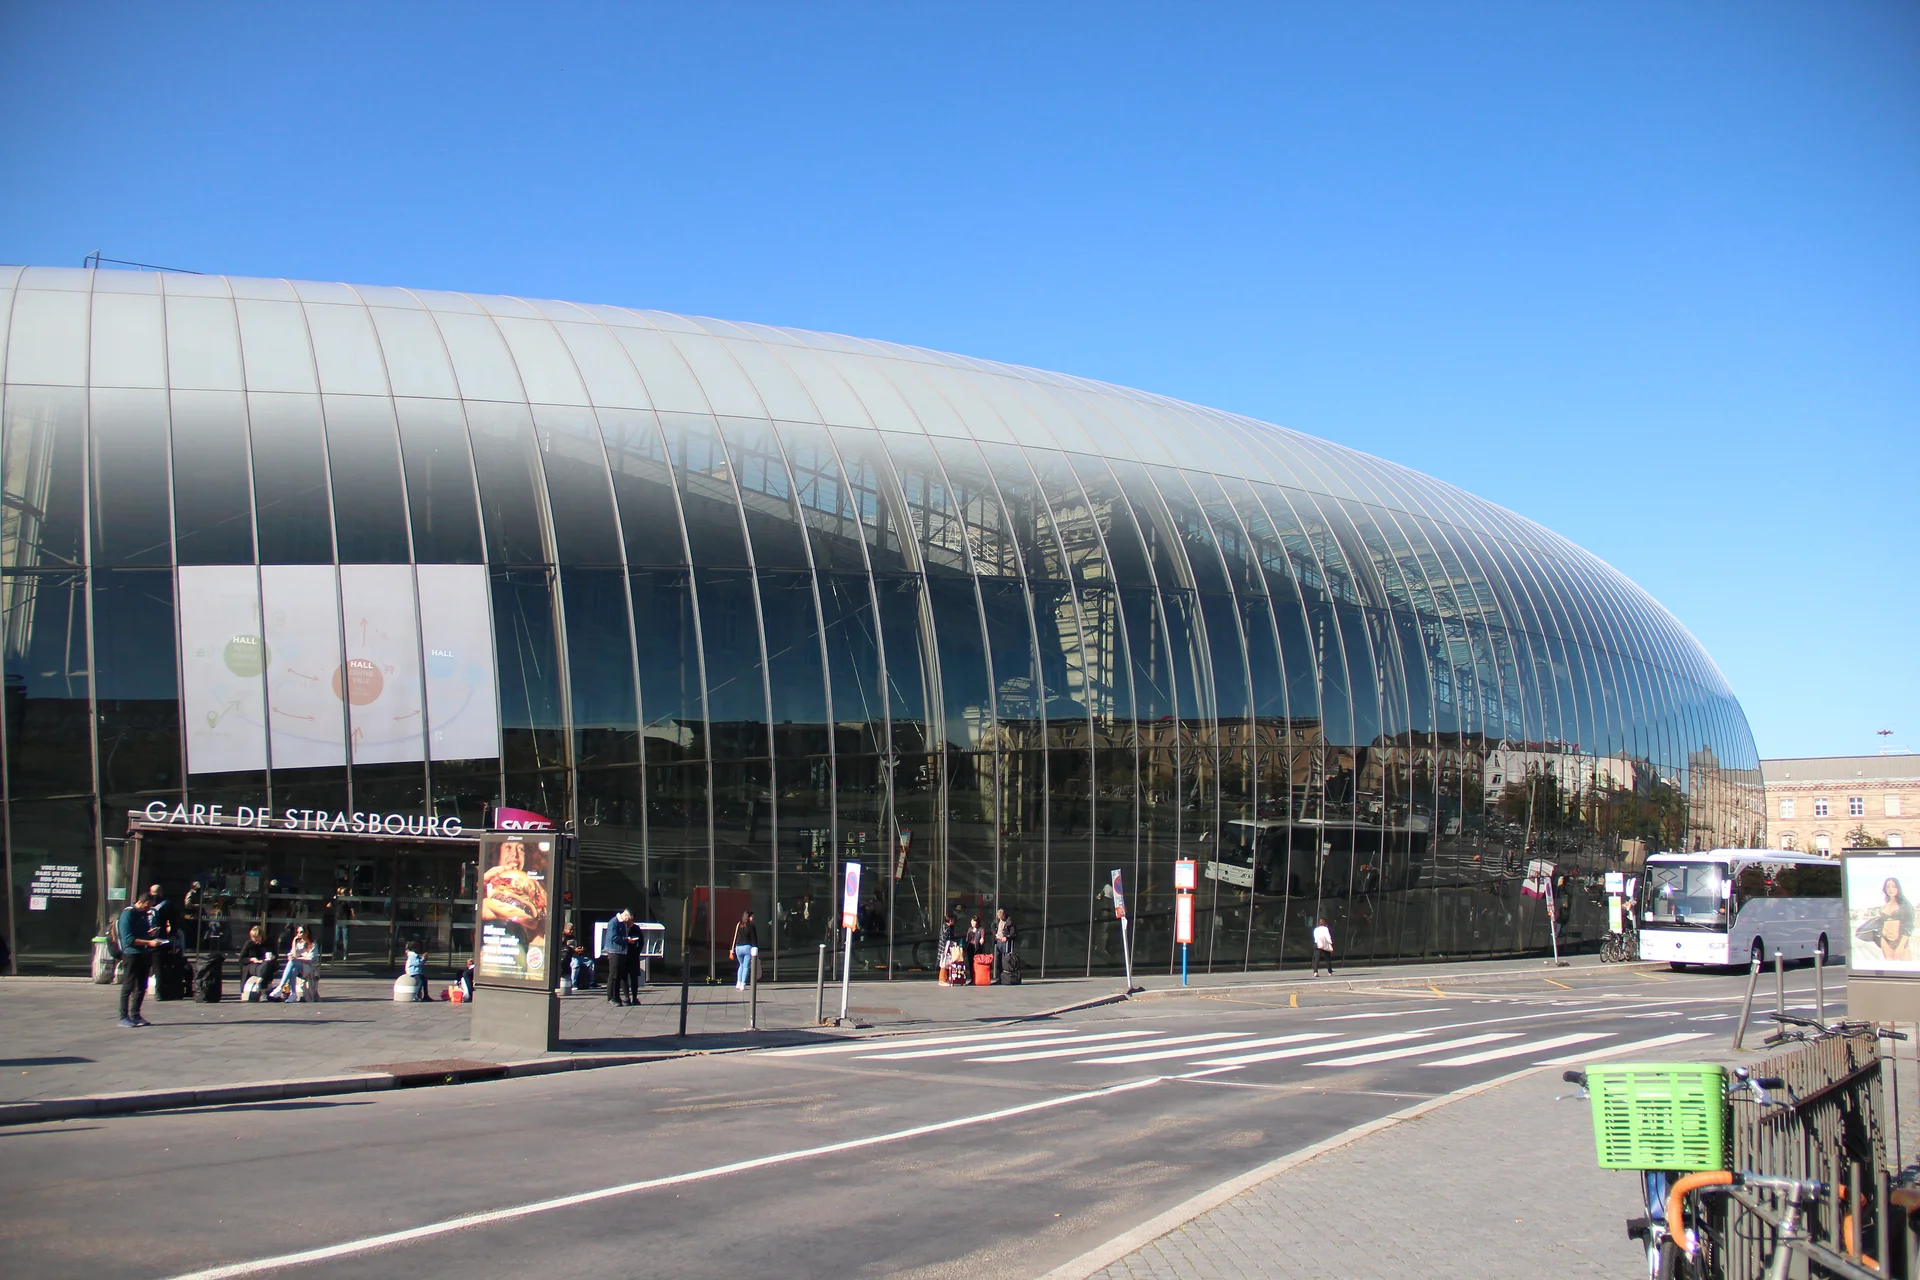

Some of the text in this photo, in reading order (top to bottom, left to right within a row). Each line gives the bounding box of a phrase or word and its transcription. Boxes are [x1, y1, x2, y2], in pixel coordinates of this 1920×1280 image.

[232, 636, 257, 645] HALL
[431, 649, 454, 658] HALL
[350, 660, 374, 669] HALL
[145, 800, 463, 837] GARE DE STRASBOURG
